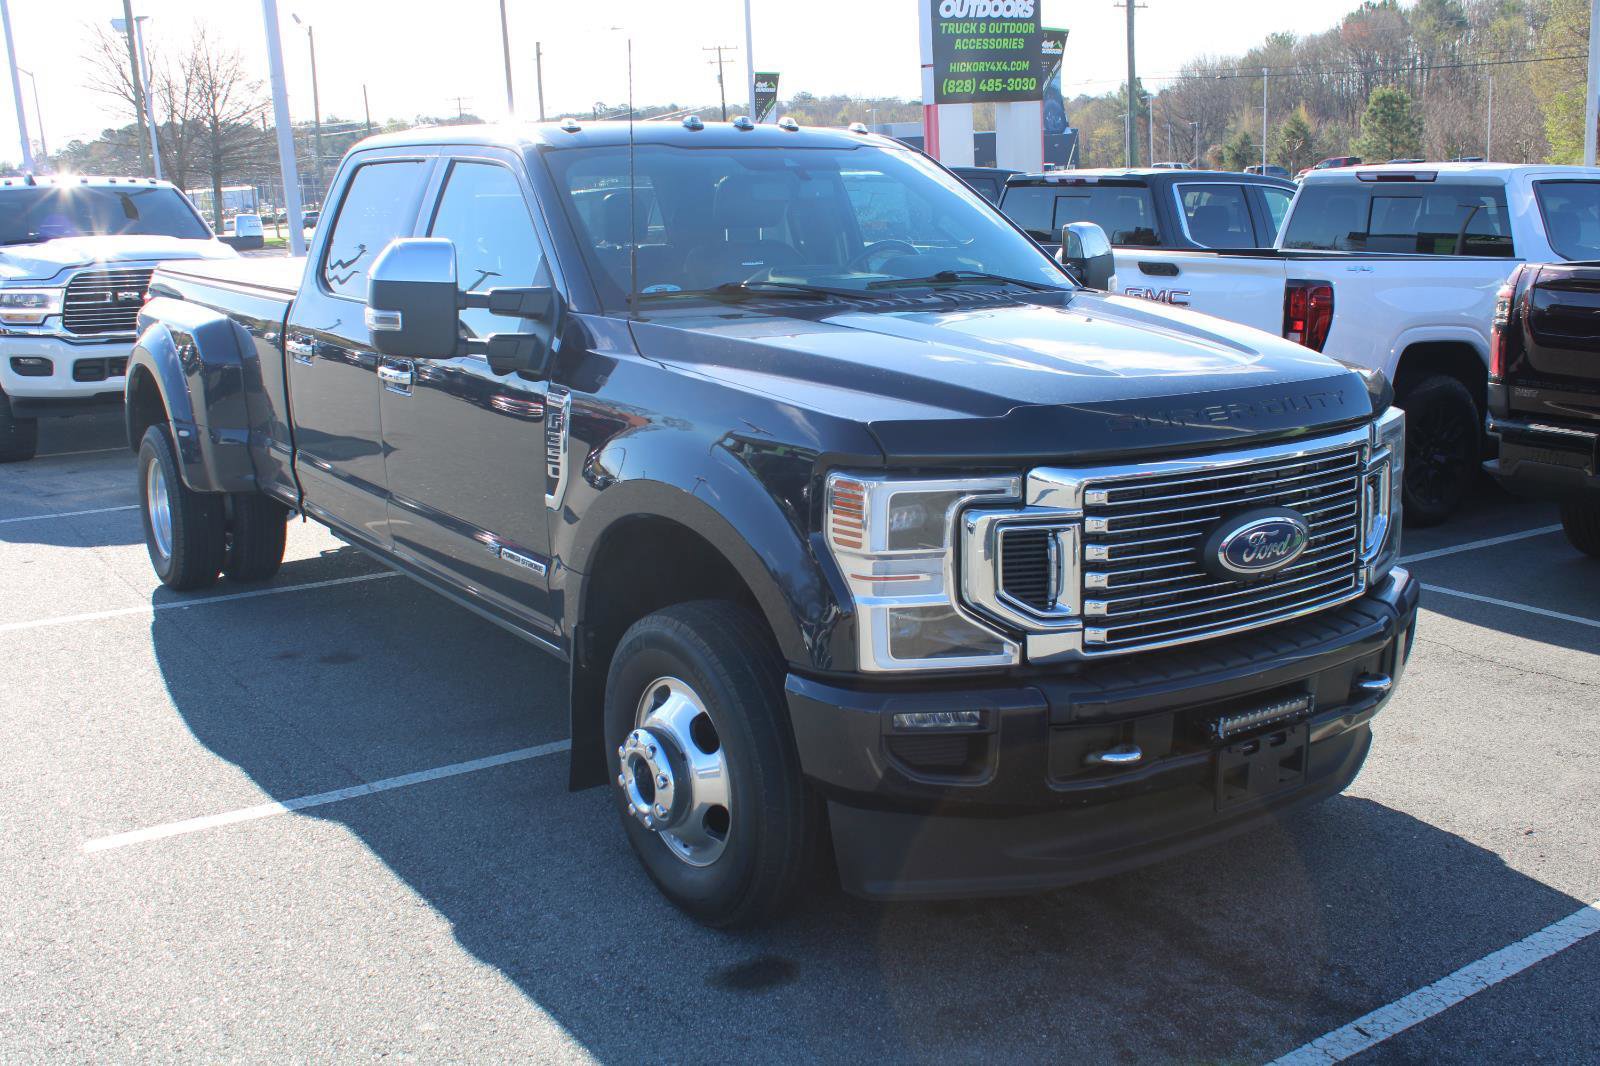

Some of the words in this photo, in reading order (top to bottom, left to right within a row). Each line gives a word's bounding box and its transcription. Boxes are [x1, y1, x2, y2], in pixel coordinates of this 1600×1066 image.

[939, 0, 1035, 18] OUTDOORS
[940, 22, 977, 34] TRUCK
[988, 22, 1036, 34] OUTDOOR
[954, 38, 1025, 50] ACCESSORIES
[949, 61, 1030, 73] HICKORY4X4.COM
[942, 78, 977, 95] (828)
[979, 77, 1037, 93] 485-3030
[1124, 287, 1191, 307] GMC
[1262, 388, 1346, 414] DUTY
[1242, 529, 1293, 563] Ford
